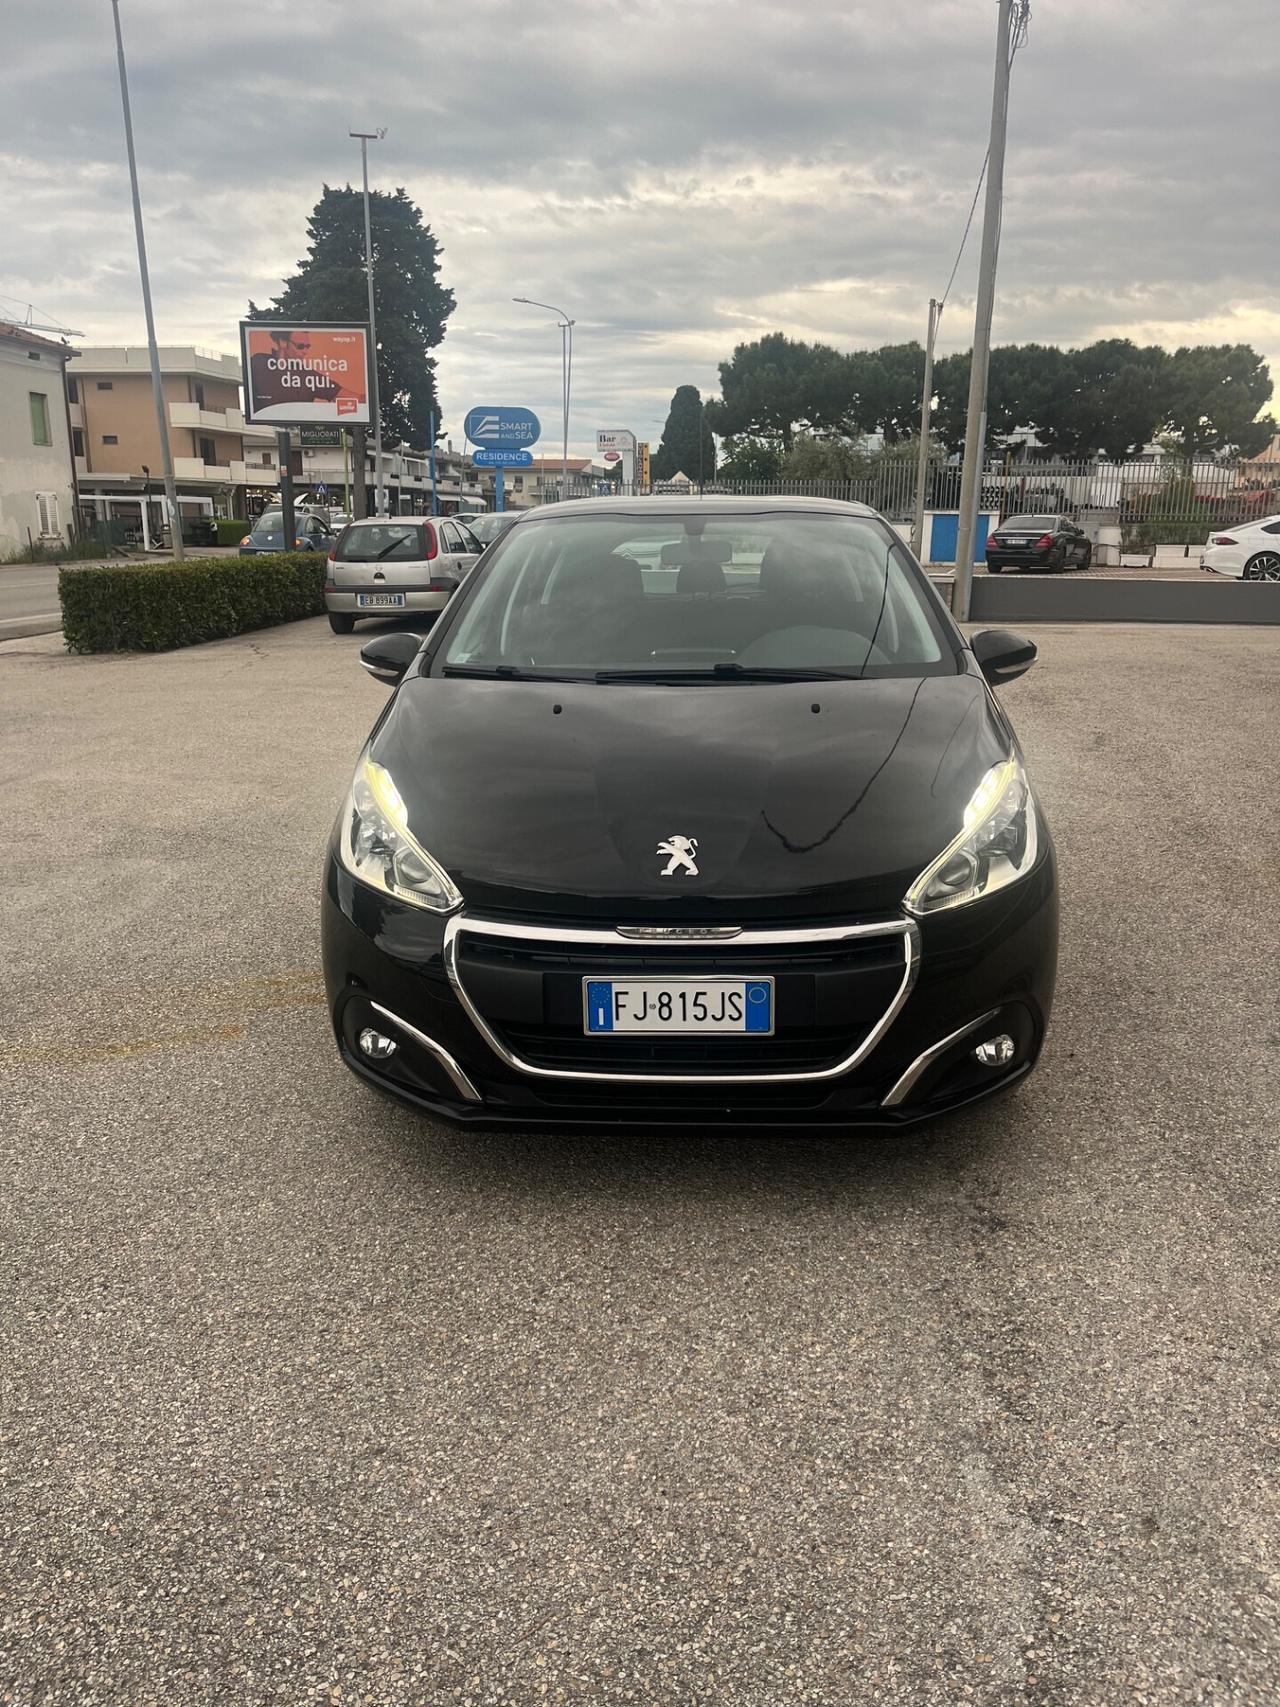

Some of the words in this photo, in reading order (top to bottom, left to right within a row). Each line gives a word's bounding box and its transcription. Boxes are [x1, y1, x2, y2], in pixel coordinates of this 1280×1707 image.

[267, 354, 348, 372] comunica
[281, 371, 300, 388] da
[305, 372, 335, 391] qui.
[500, 422, 534, 431] SMART
[515, 432, 533, 440] SEA
[476, 452, 528, 461] RESIDENCE
